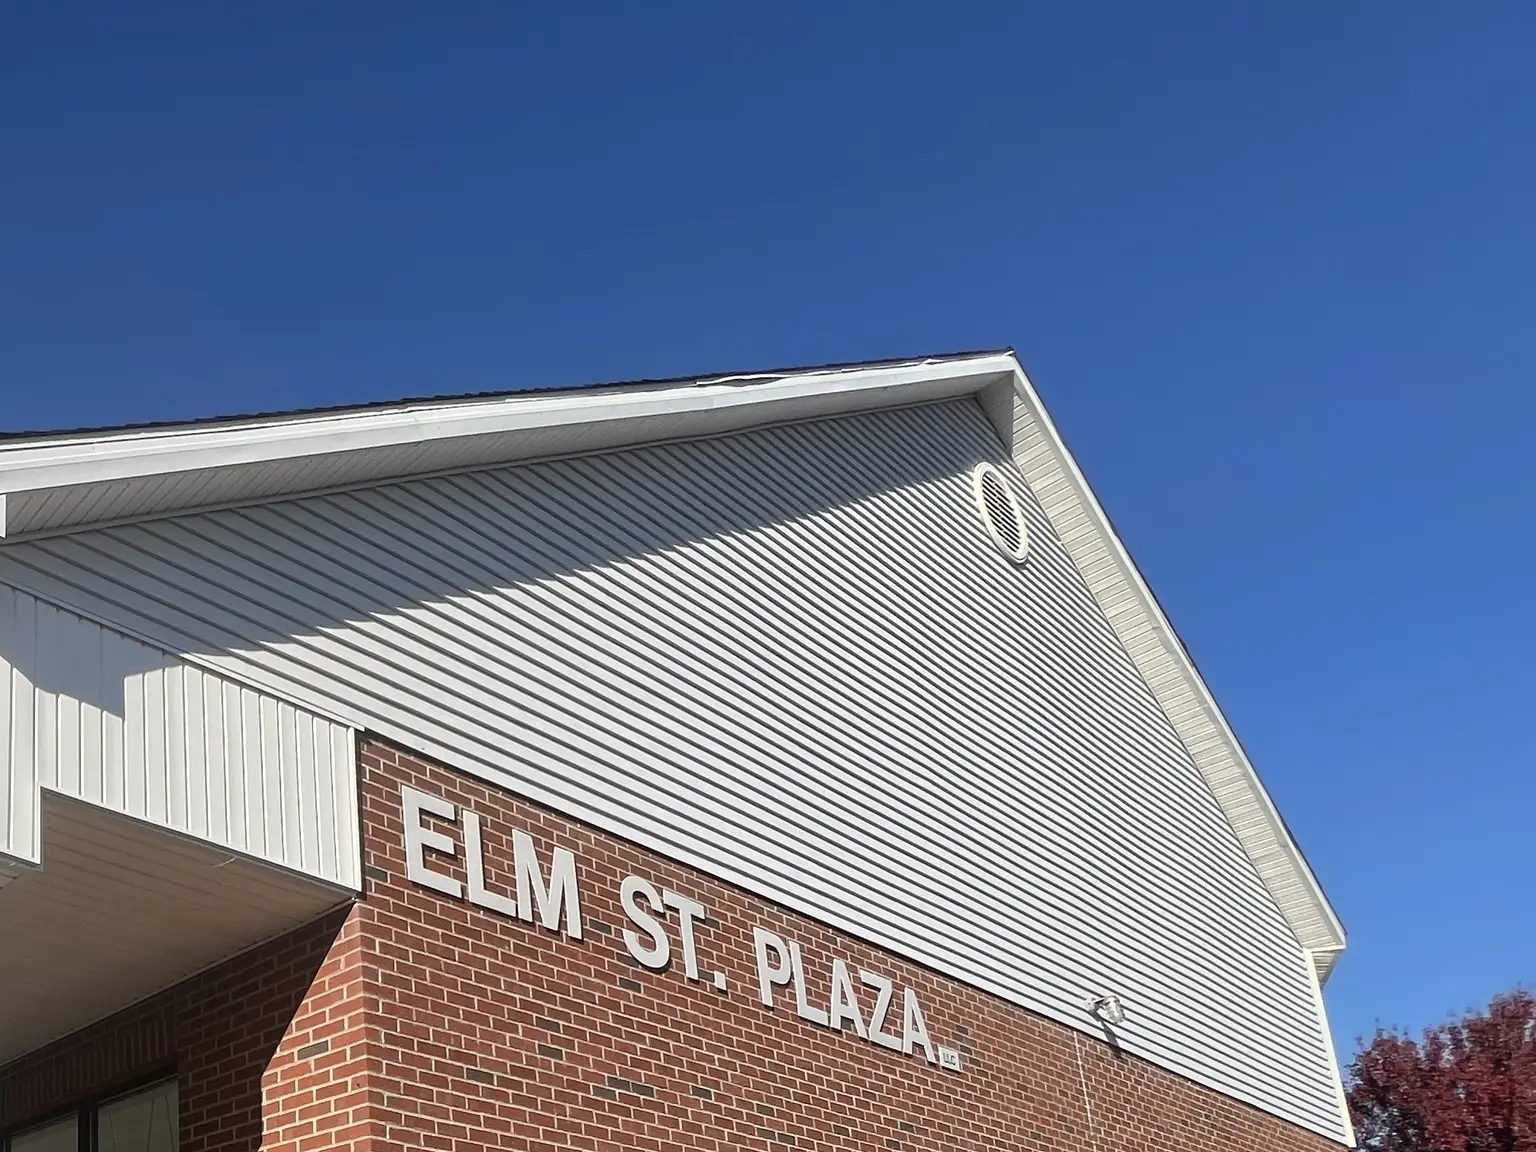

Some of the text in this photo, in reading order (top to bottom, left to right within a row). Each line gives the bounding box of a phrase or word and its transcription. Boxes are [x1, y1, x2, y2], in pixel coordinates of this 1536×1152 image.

[401, 784, 936, 1064] ELM ST. PLAZA
